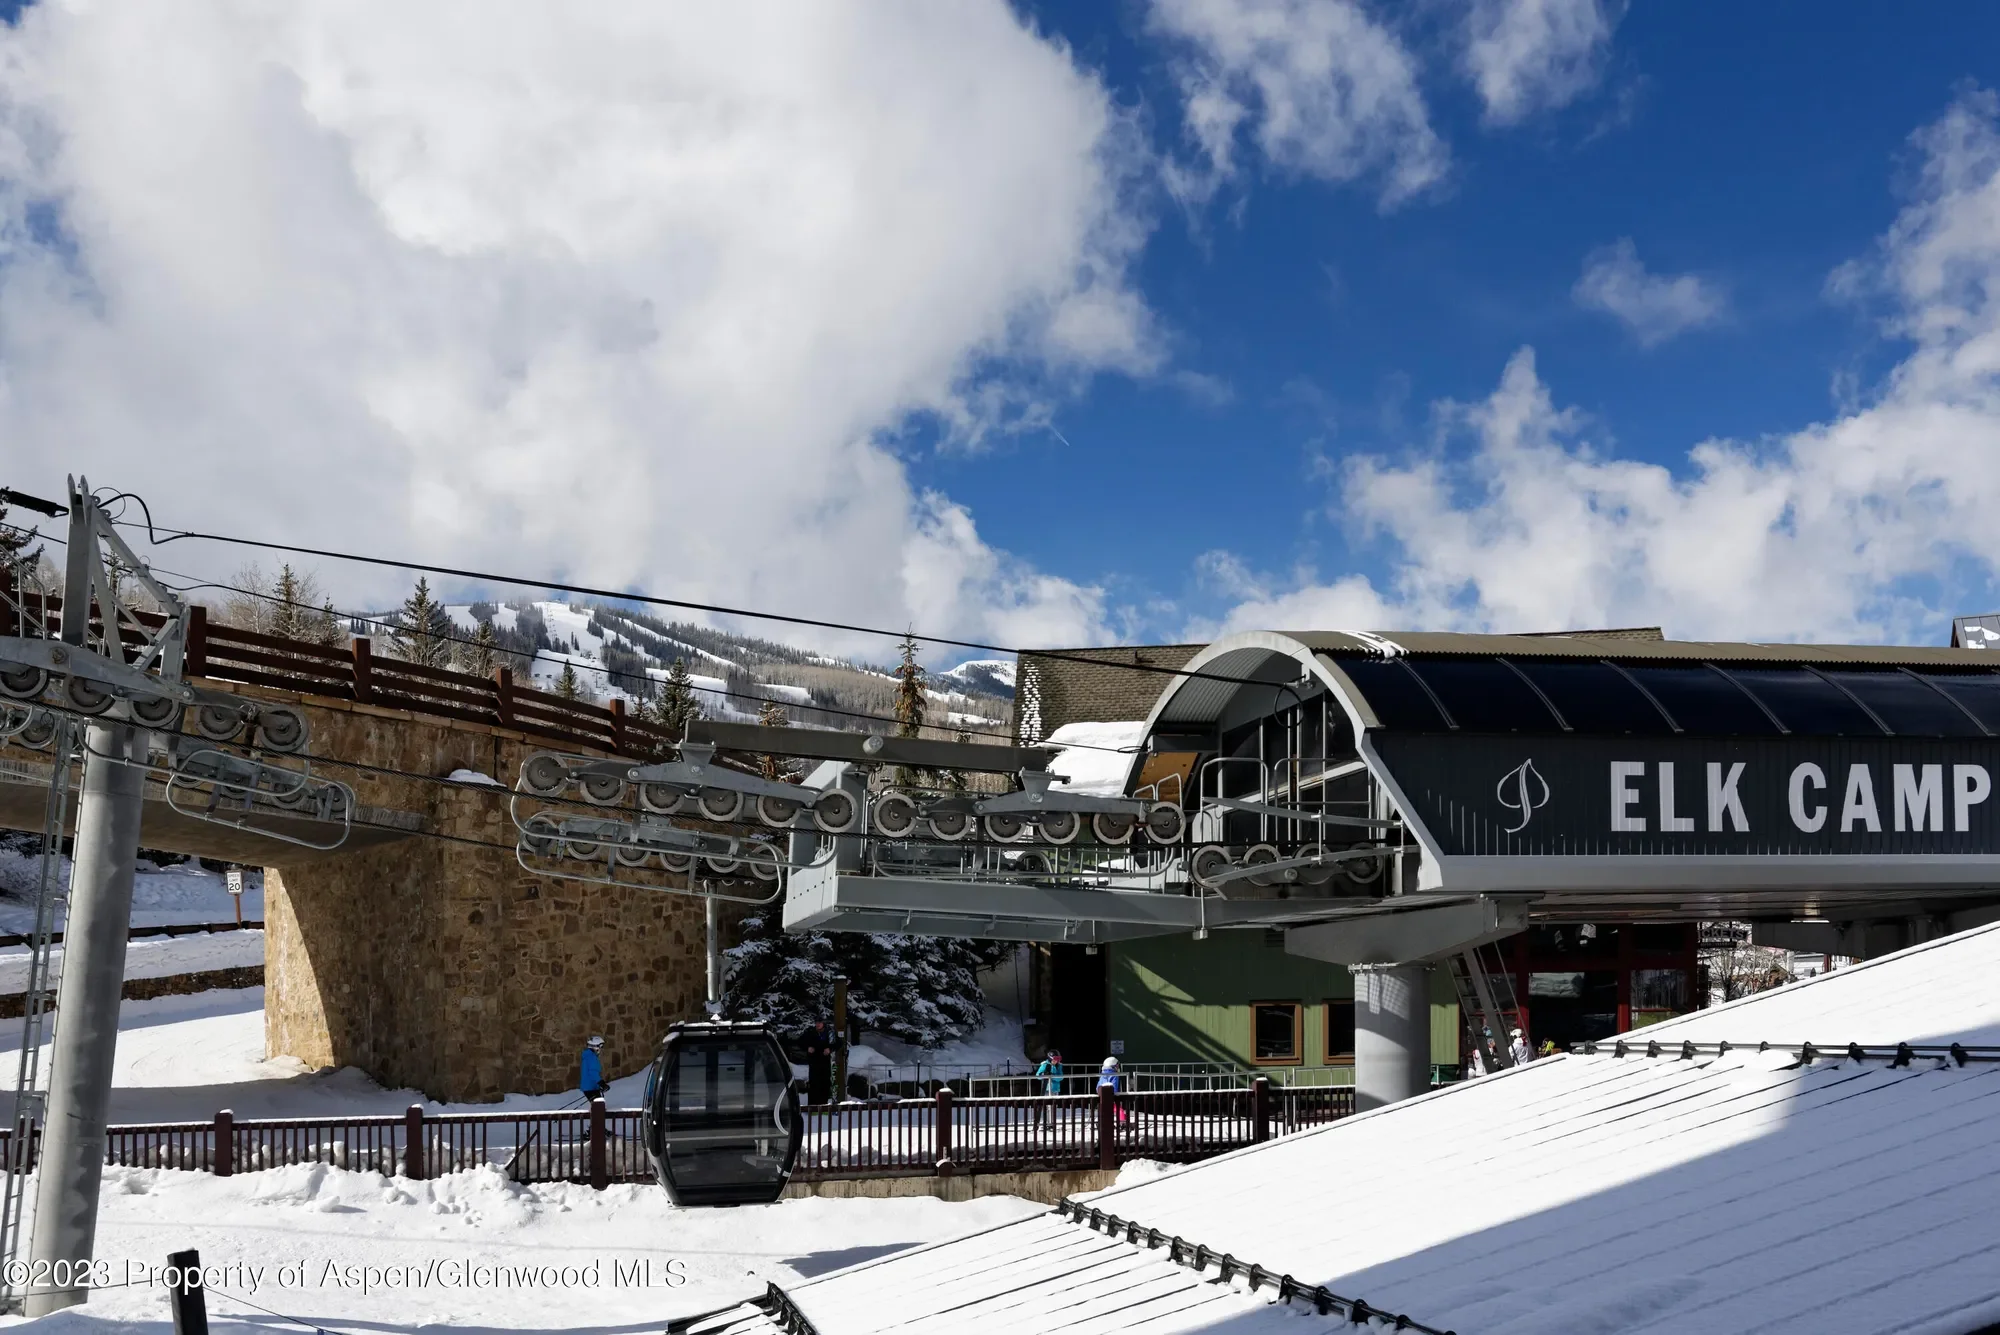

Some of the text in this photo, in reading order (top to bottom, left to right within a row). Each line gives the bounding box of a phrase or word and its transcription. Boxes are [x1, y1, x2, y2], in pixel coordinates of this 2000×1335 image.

[1610, 761, 1992, 833] ELK CAMP
[229, 882, 240, 890] 20
[1697, 929, 1744, 940] ICKETS
